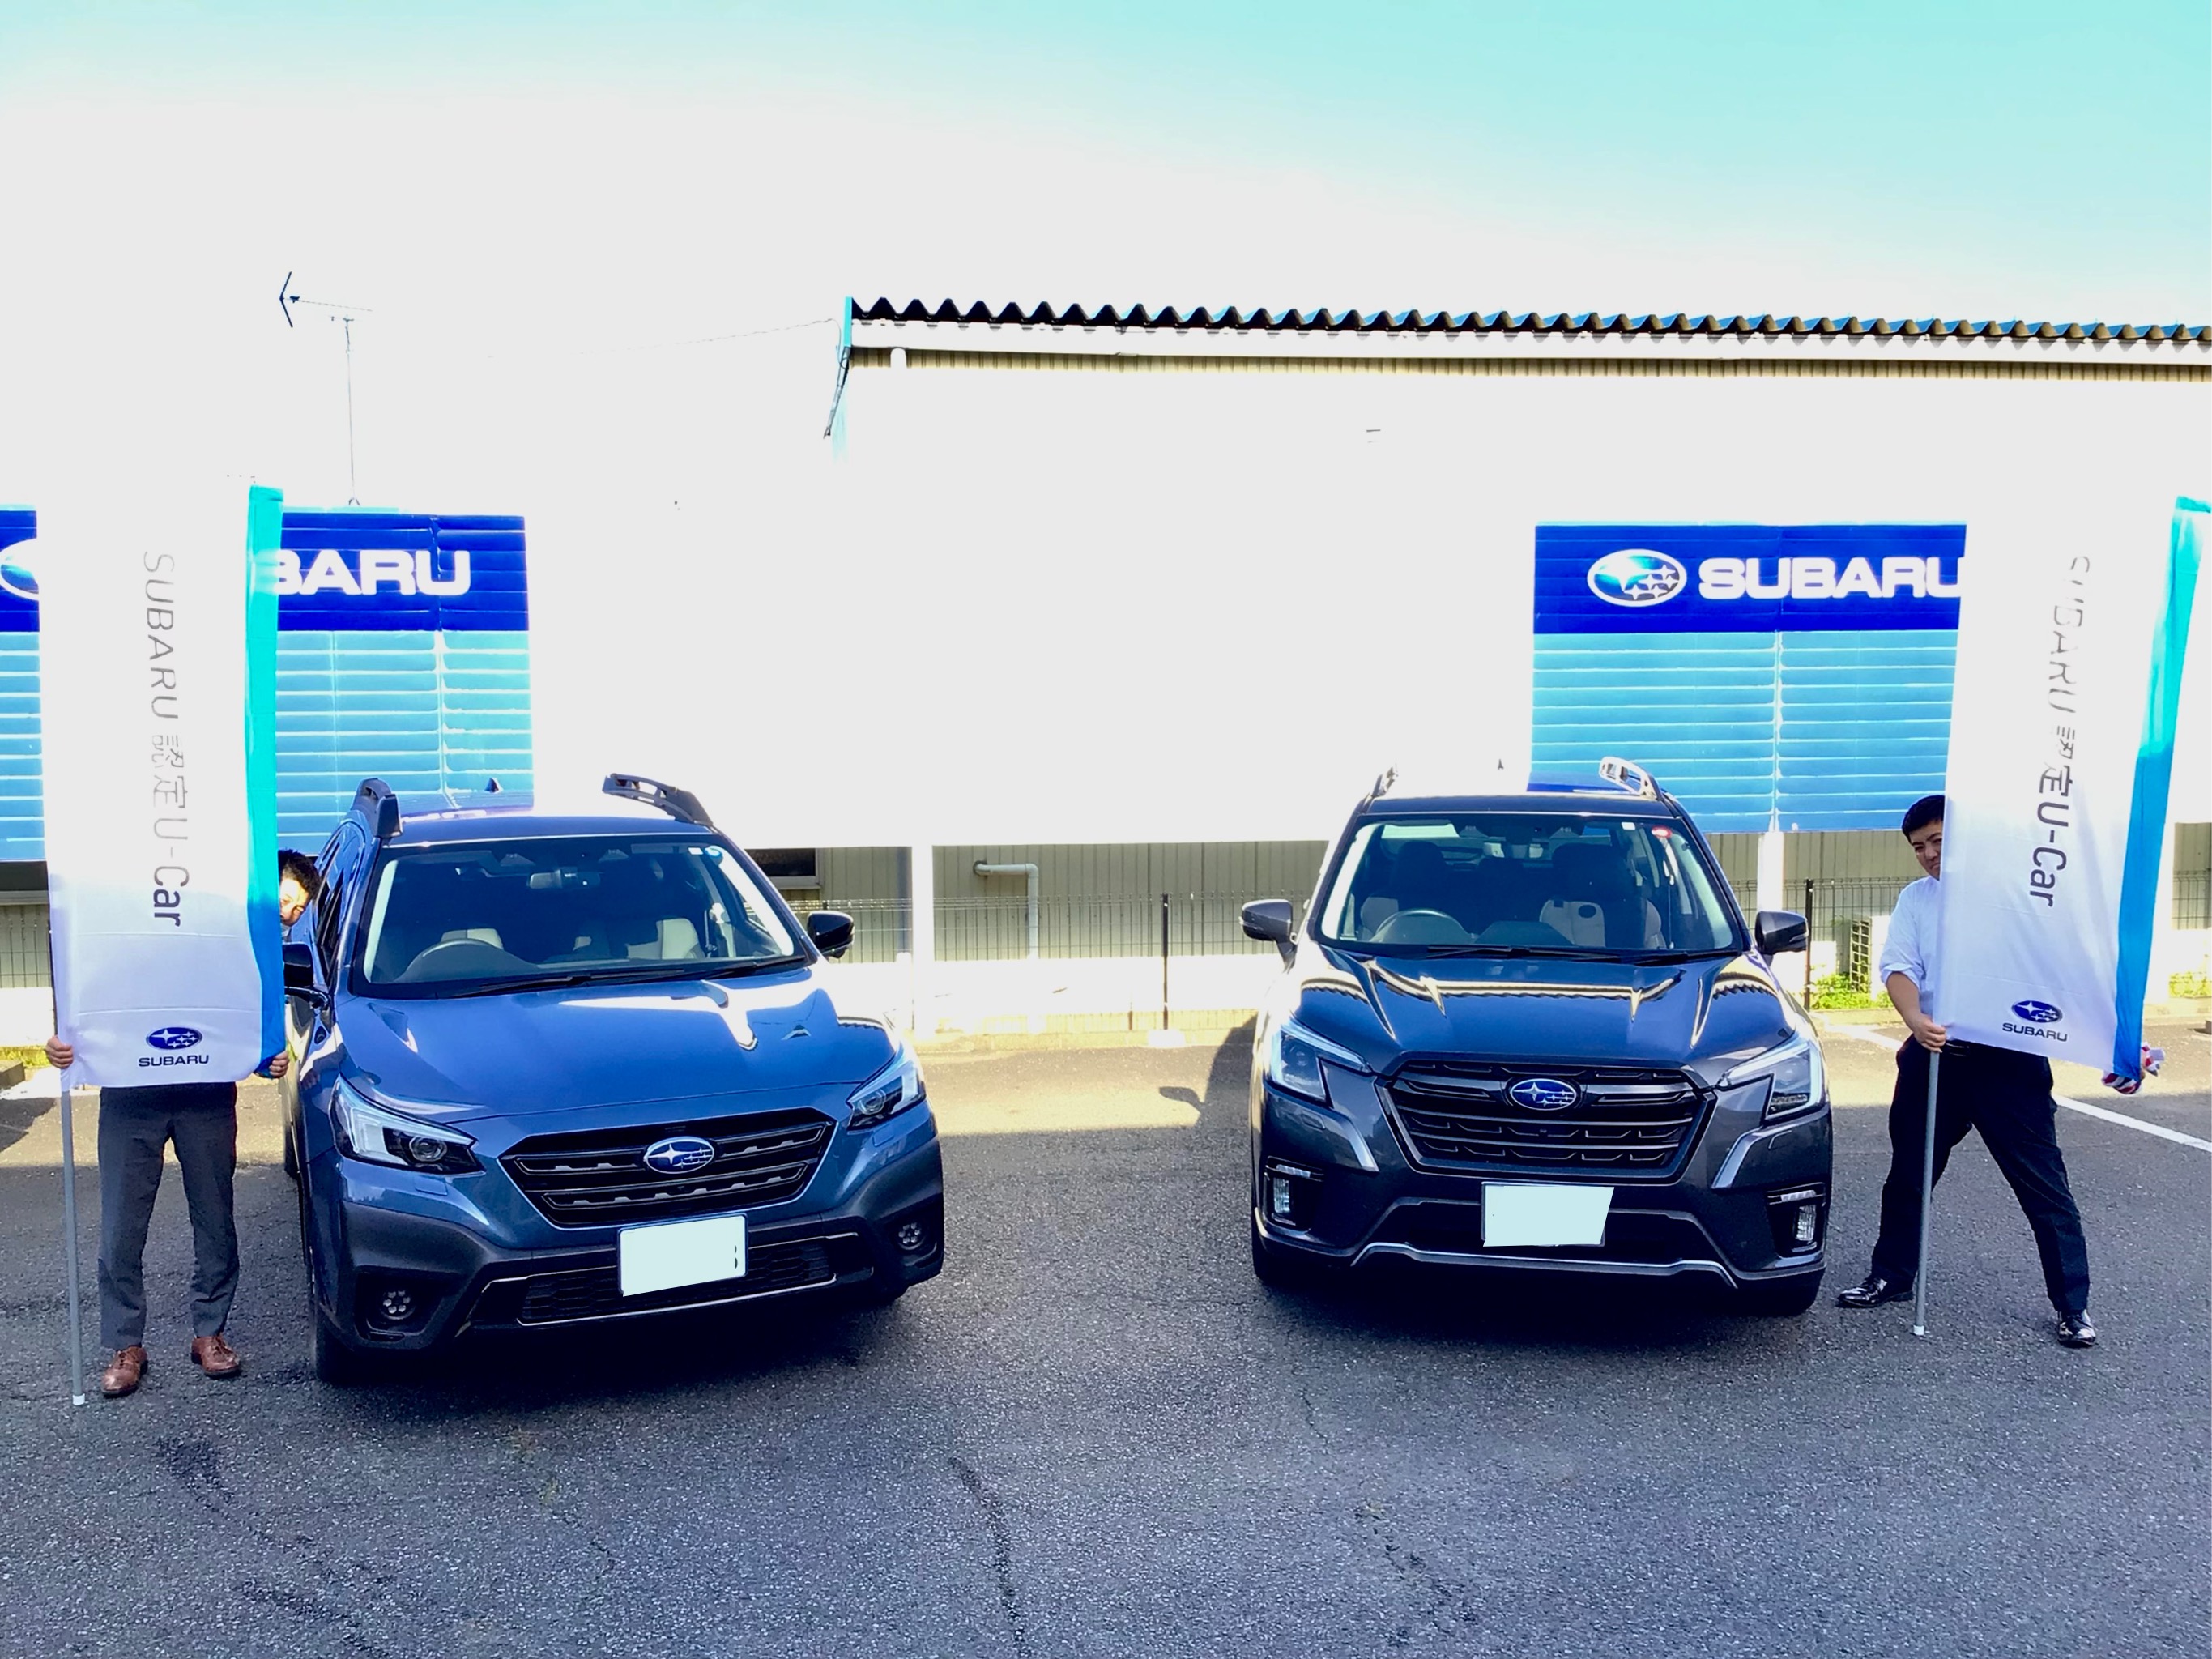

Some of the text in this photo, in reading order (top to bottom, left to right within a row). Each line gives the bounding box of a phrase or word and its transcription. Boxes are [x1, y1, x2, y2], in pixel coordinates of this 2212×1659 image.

[256, 548, 471, 596] BARU
[1698, 556, 1965, 600] SUBARU
[143, 551, 179, 719] SUBARU
[2001, 1021, 2069, 1043] SUBARU
[138, 1054, 210, 1068] SUBARU
